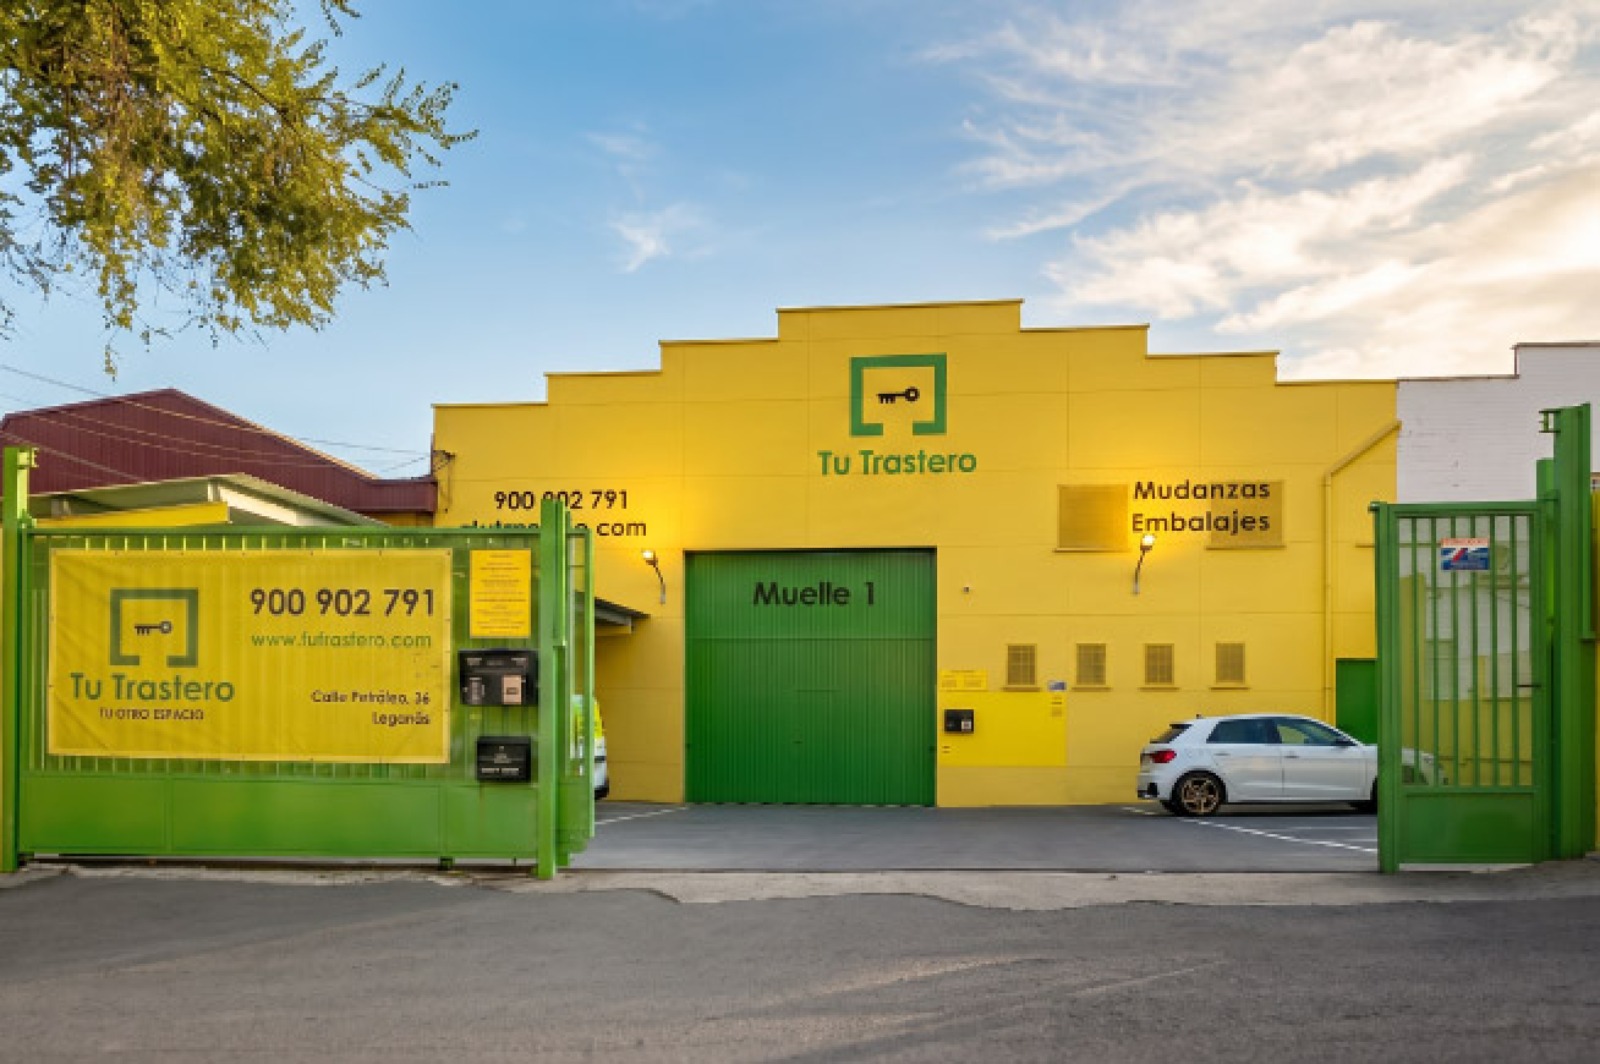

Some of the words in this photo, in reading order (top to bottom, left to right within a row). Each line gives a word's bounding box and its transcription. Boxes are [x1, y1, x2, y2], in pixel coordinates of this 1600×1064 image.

[817, 450, 850, 475] Tu
[859, 450, 977, 475] Trastero
[494, 490, 534, 510] 900
[591, 489, 628, 509] 791
[1134, 479, 1270, 499] Mudanzas
[1132, 509, 1270, 536] Embalajes
[251, 588, 305, 615] 900
[317, 588, 371, 616] 902
[383, 588, 434, 616] 791
[753, 581, 851, 606] Muelle
[865, 582, 874, 605] 1
[251, 631, 432, 648] www.tutrastero.com
[70, 673, 101, 700] Tu
[112, 673, 235, 702] Trastero
[311, 690, 347, 703] Calle
[99, 708, 113, 720] TU
[115, 708, 149, 720] OTRO
[153, 708, 204, 720] ESPACIO
